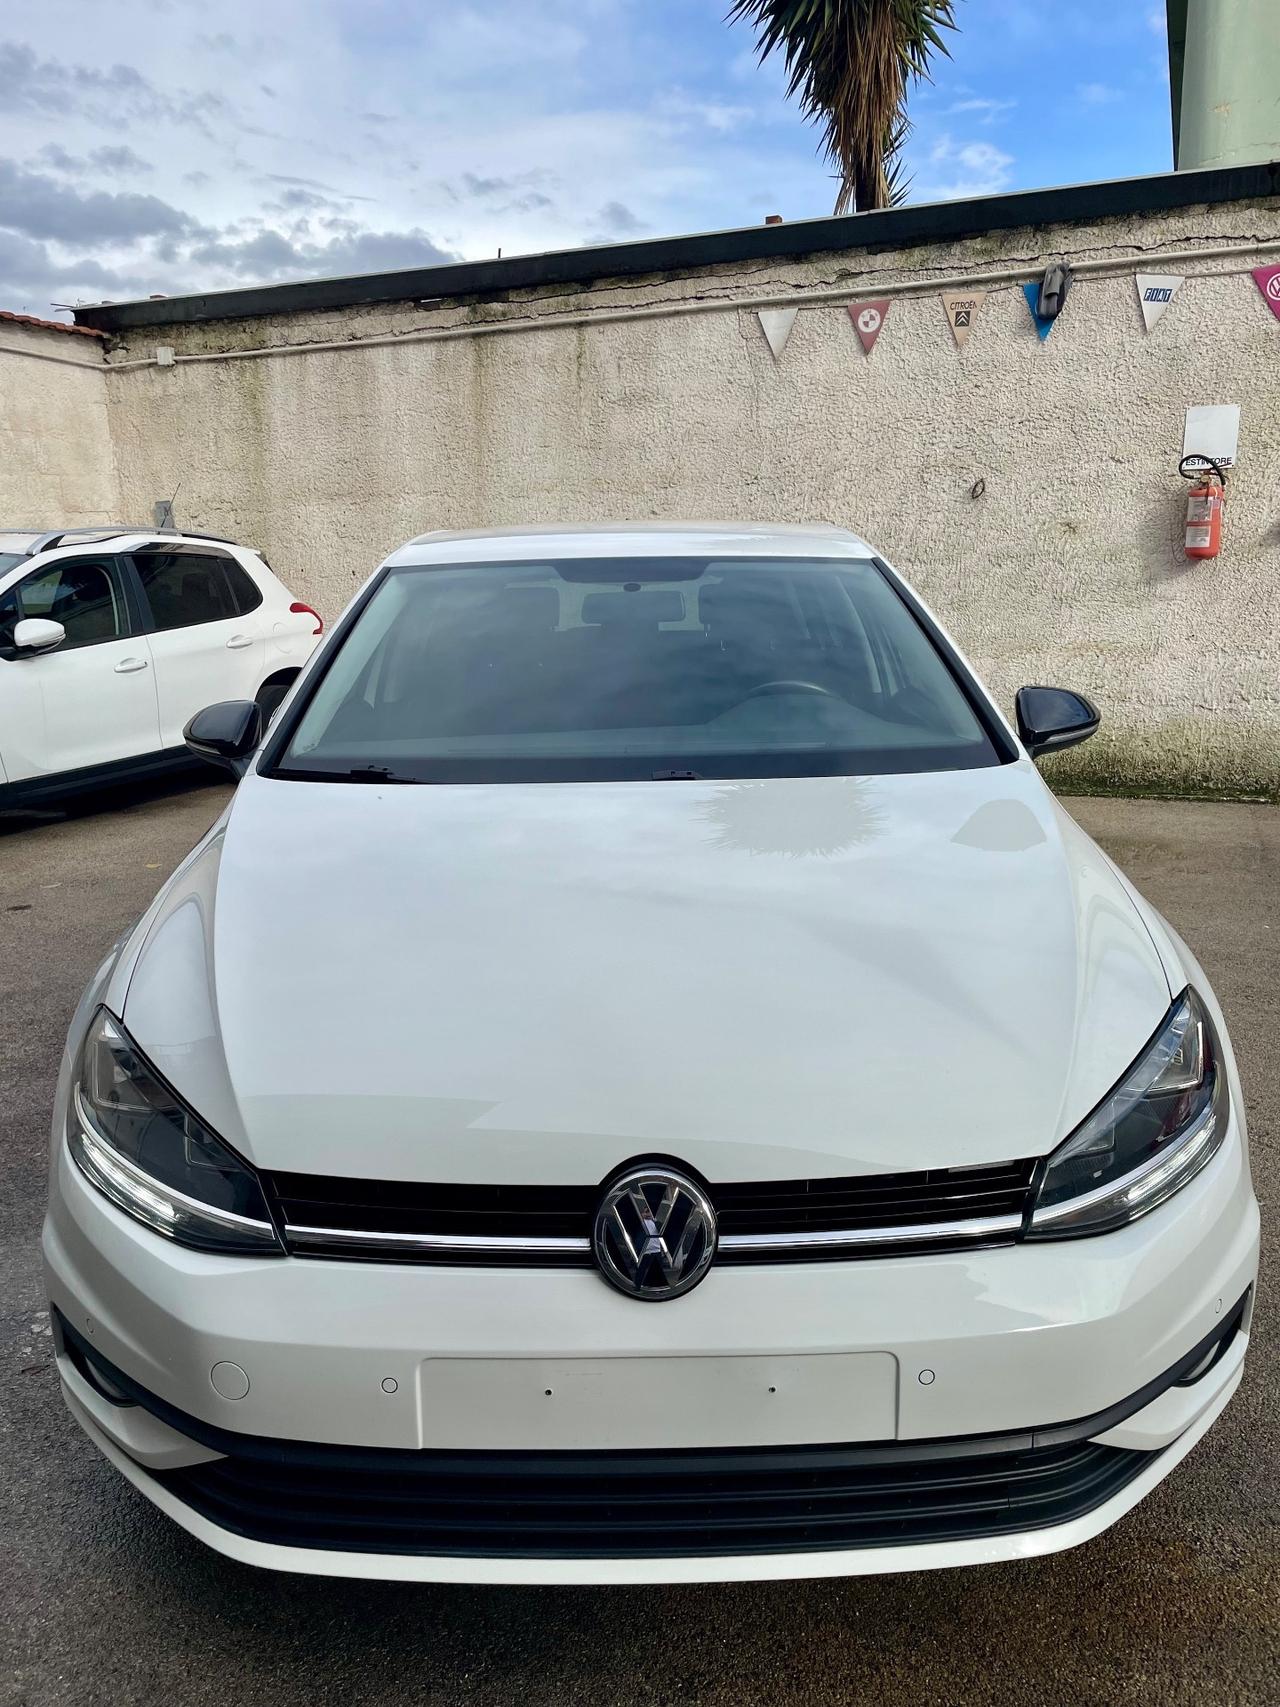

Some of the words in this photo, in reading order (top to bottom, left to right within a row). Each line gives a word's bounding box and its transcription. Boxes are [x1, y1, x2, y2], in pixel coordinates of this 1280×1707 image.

[1144, 288, 1172, 302] FIAT
[1185, 457, 1232, 466] ESTINORE
[601, 1178, 707, 1291] VW
